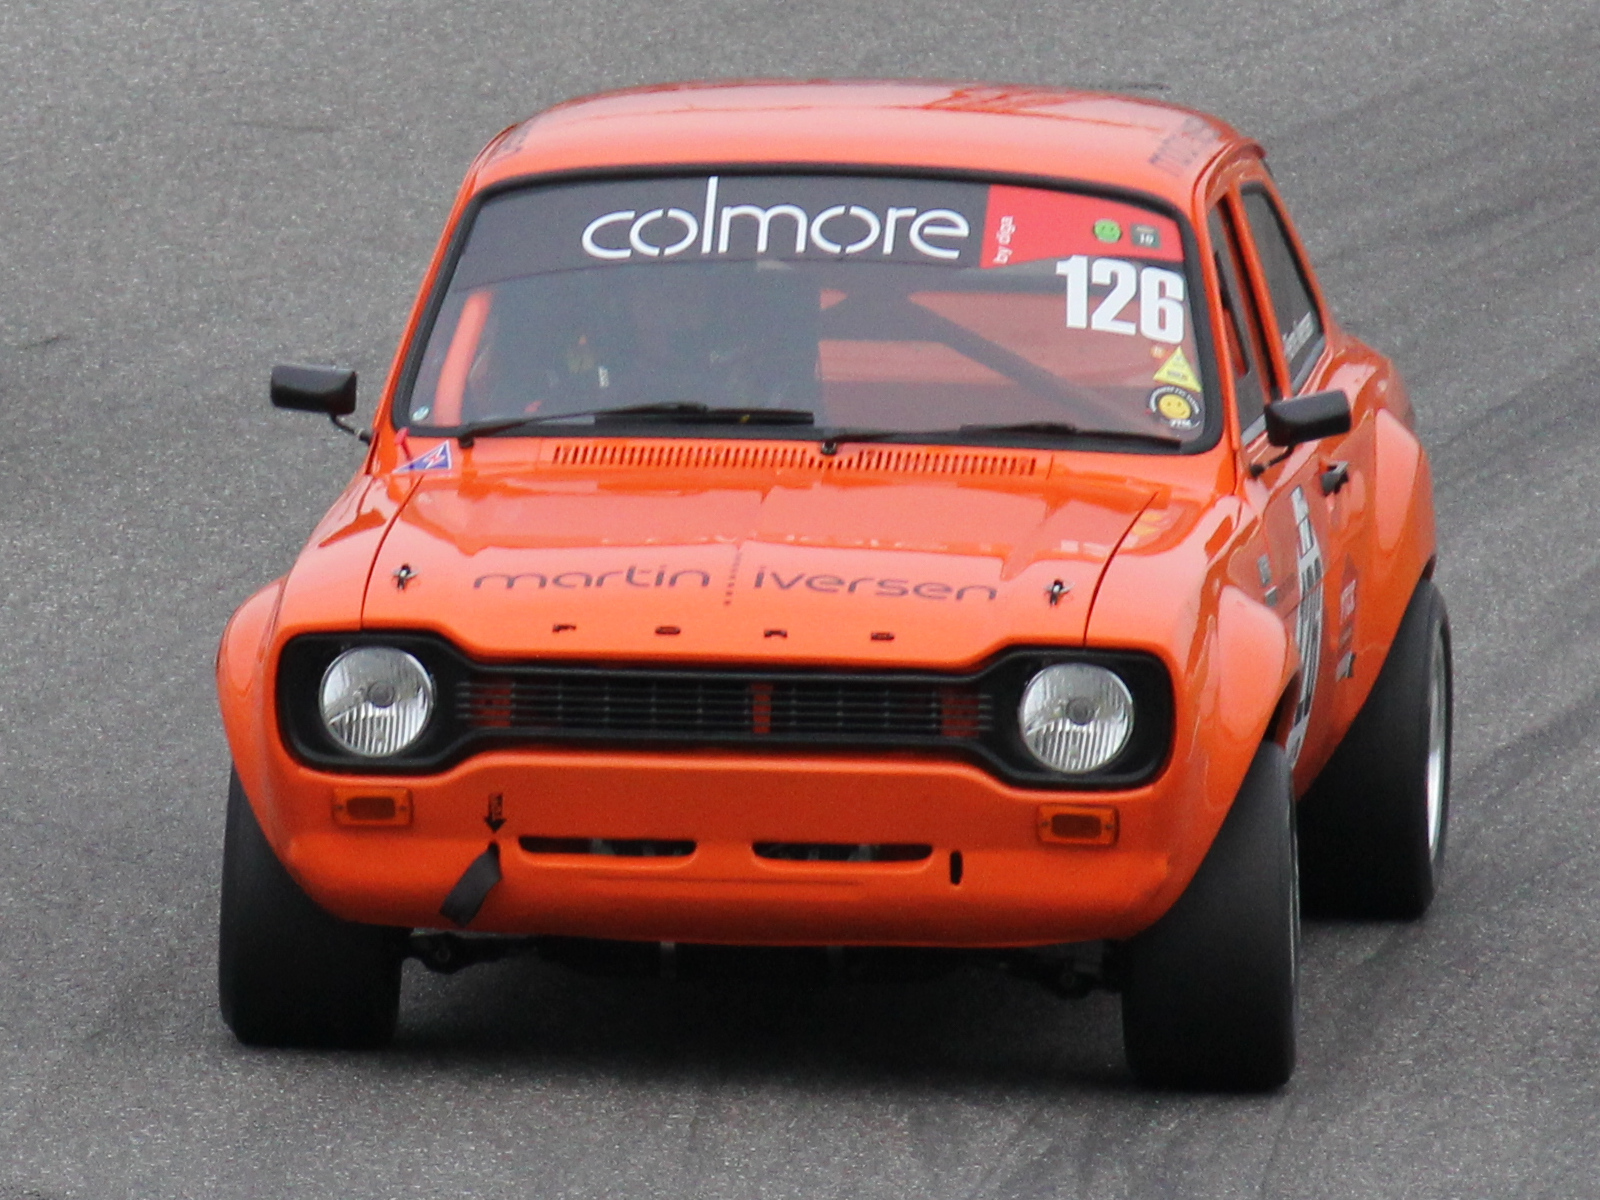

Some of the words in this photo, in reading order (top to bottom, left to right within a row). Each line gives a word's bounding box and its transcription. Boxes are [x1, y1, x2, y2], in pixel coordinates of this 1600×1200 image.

[581, 175, 970, 259] colmore
[1055, 254, 1185, 344] 126
[472, 564, 710, 591] martin
[754, 566, 998, 603] iversen
